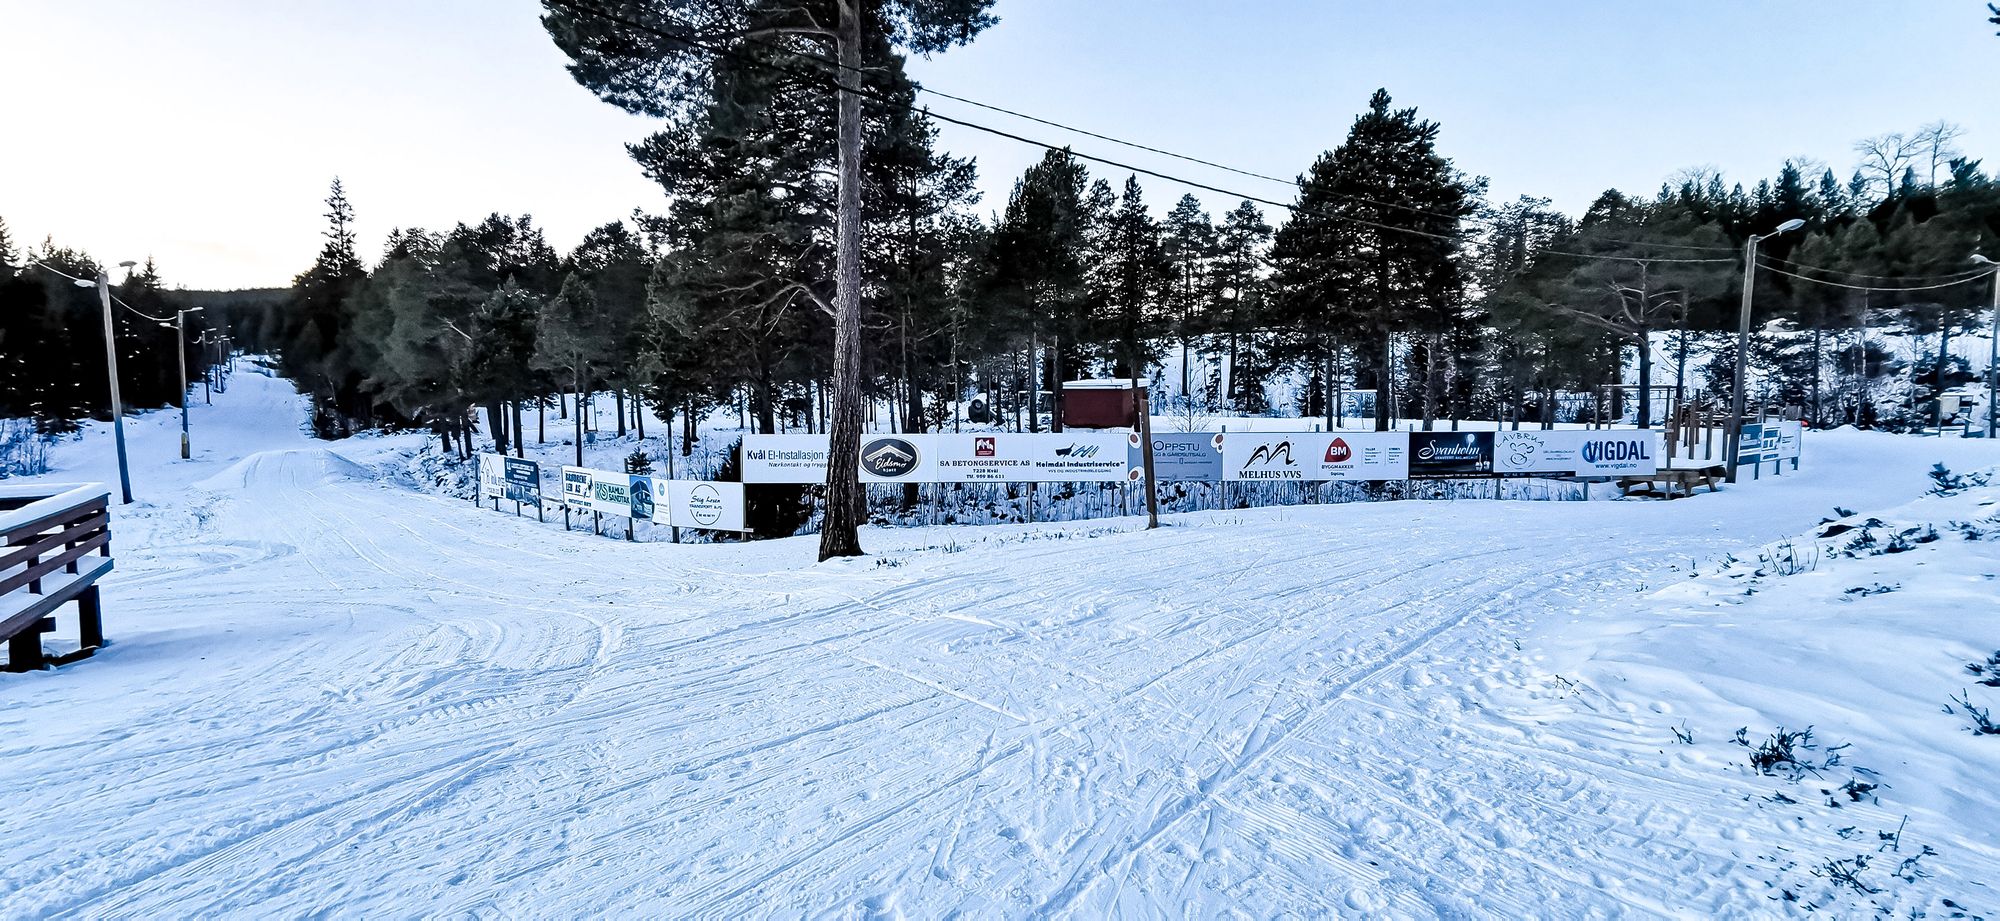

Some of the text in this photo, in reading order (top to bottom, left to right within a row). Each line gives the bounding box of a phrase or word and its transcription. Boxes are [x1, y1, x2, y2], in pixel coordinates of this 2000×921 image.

[1153, 440, 1200, 451] OPPSTU
[1330, 446, 1347, 455] BM
[1418, 440, 1480, 459] Svanholm
[1587, 440, 1650, 461] VIGDAL
[747, 450, 766, 460] Kvål
[768, 450, 824, 462] El-Installasjon
[1239, 470, 1302, 478] MELHUS VVS
